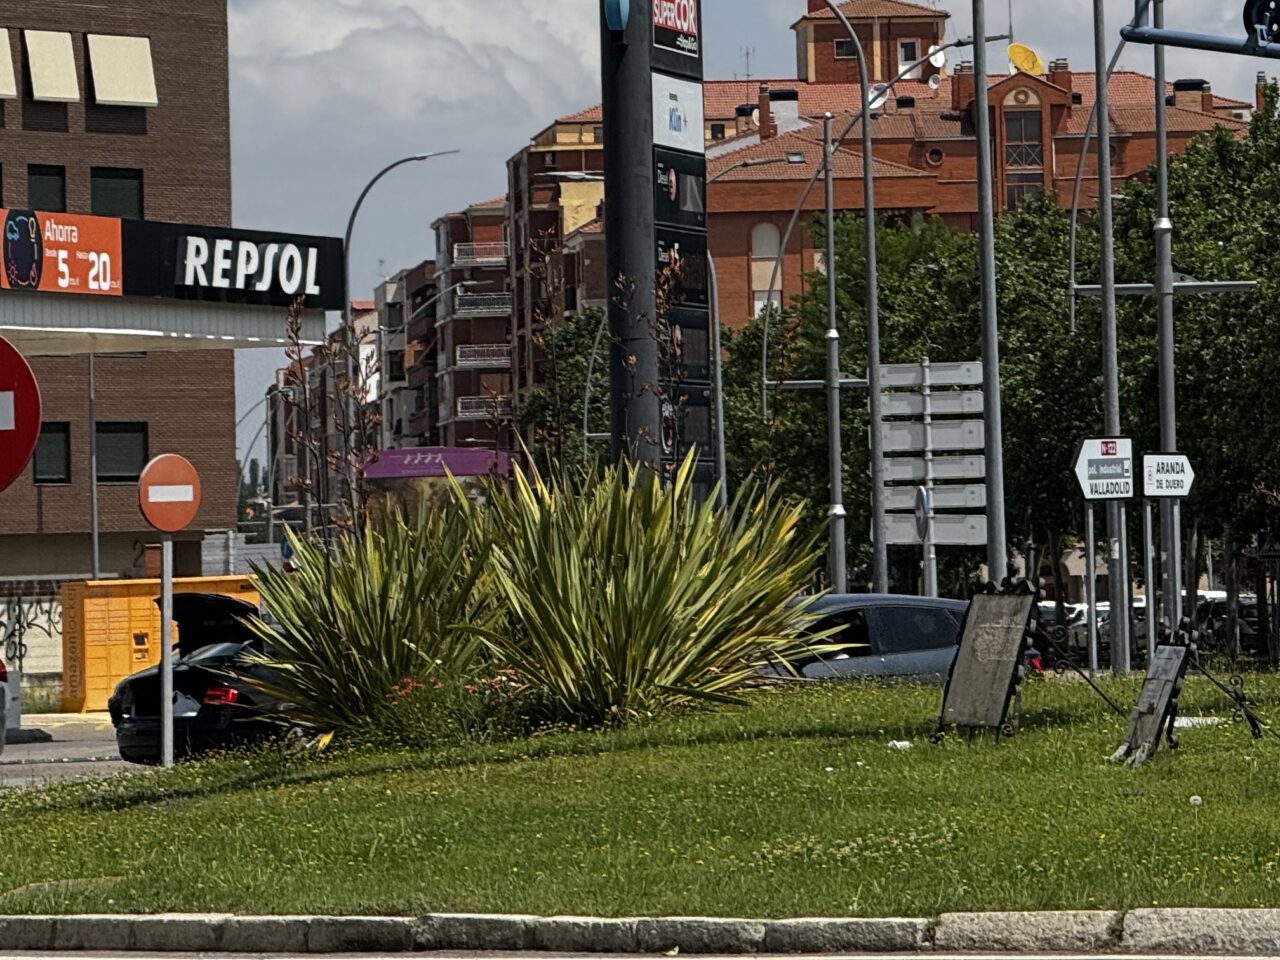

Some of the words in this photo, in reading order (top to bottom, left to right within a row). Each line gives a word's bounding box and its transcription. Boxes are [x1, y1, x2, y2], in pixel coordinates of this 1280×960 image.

[44, 219, 78, 243] Ahorra
[57, 249, 69, 288] 5
[88, 251, 111, 291] 20
[184, 235, 321, 295] REPSOL
[1156, 461, 1185, 475] ARANDA
[1090, 481, 1130, 495] VALLADOLID
[1156, 479, 1164, 489] DE
[1165, 479, 1184, 489] DUERO
